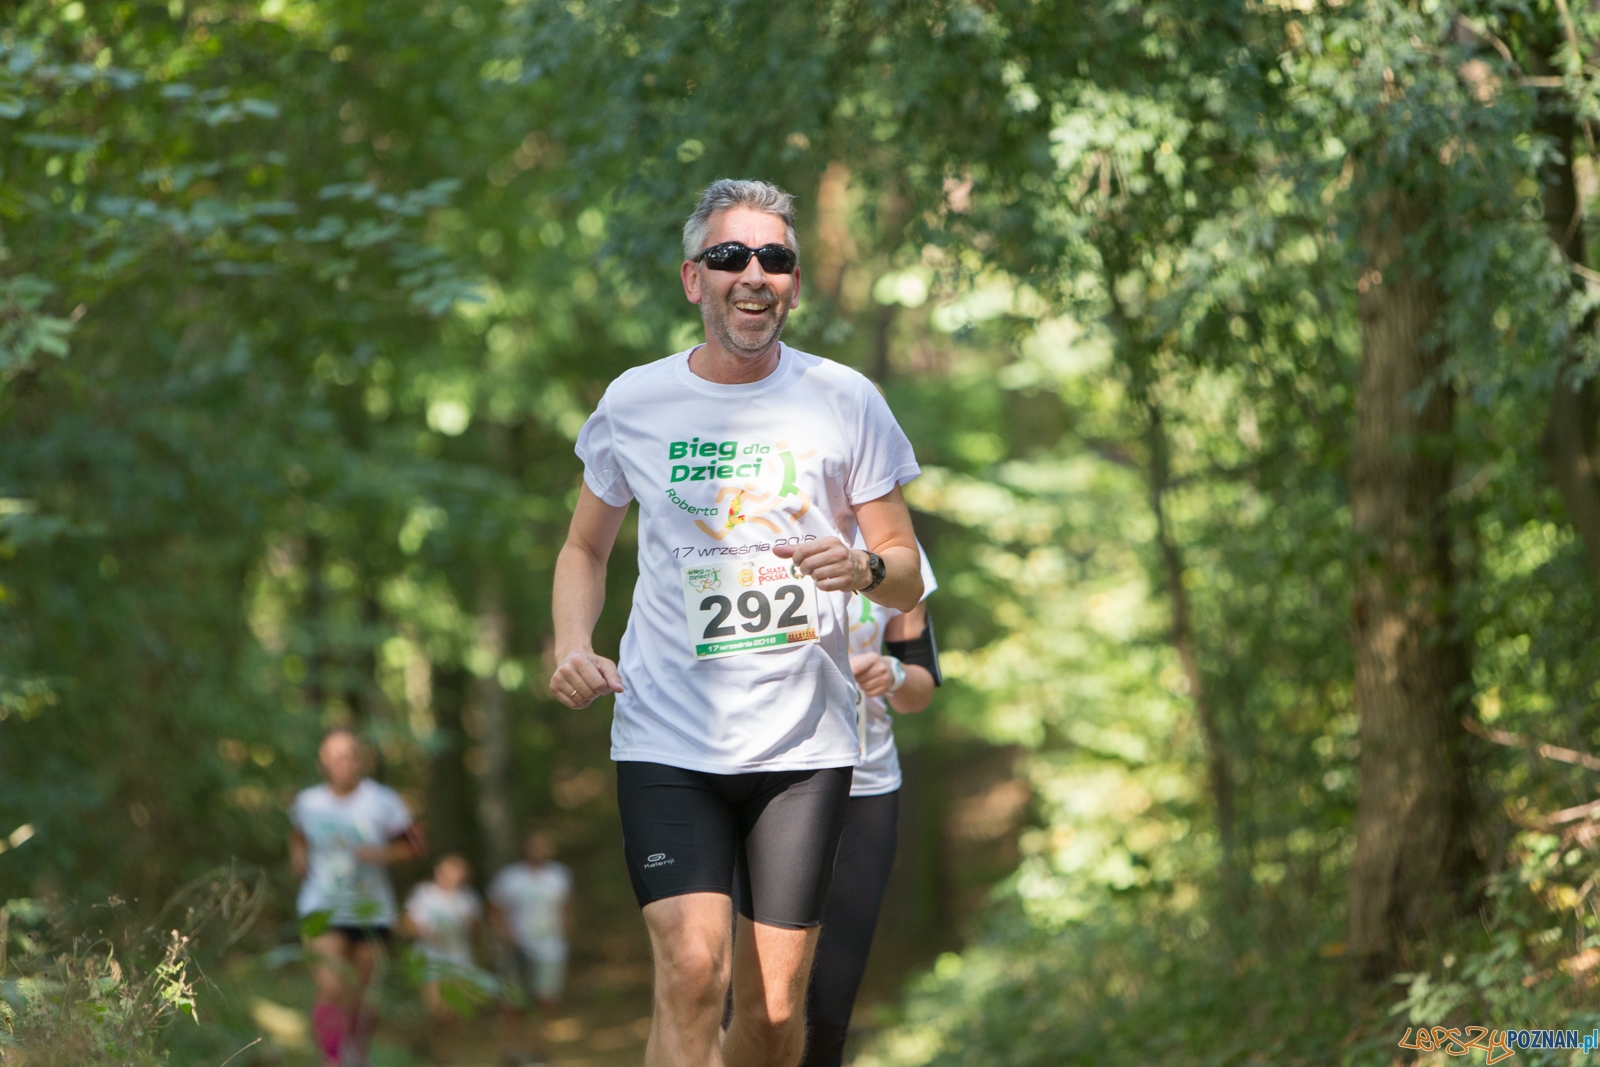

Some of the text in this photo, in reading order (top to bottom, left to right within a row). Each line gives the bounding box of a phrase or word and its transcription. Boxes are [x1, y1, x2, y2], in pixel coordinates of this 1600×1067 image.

[669, 437, 770, 461] Bieg dla
[670, 458, 762, 483] Dzieci
[665, 488, 719, 516] Roberta
[672, 547, 695, 559] 17
[698, 541, 770, 557] września
[758, 573, 790, 585] POLSKA
[699, 584, 808, 639] 292
[753, 637, 776, 647] 2016
